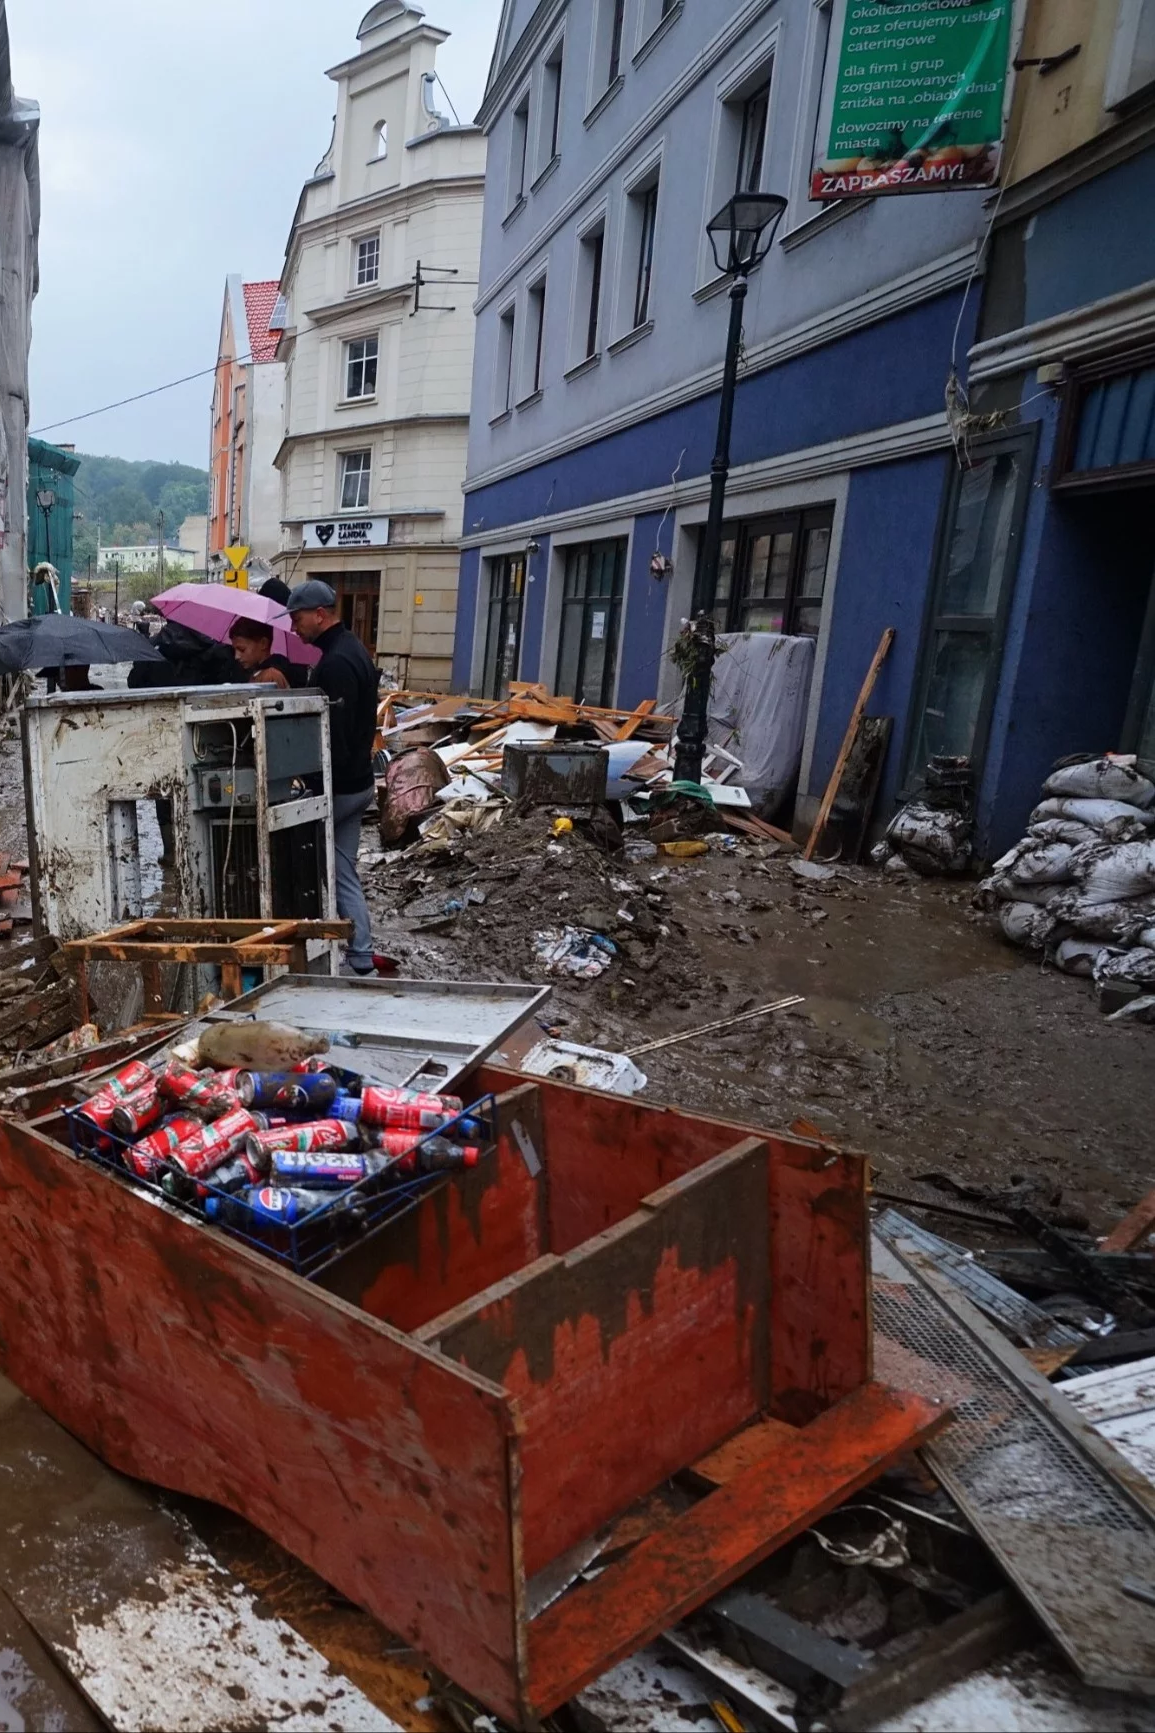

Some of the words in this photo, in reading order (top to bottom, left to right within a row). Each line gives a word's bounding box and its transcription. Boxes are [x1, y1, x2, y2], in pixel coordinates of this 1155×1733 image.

[849, 23, 880, 36] oraz
[884, 12, 958, 32] oferujemy
[962, 6, 1005, 24] usługi
[847, 33, 936, 52] cateringowe
[844, 64, 865, 77] dla
[869, 62, 898, 74] firm
[910, 58, 944, 73] grup
[842, 72, 966, 94] zorganizowanych
[840, 95, 884, 110] zniżka
[888, 95, 905, 105] na
[837, 118, 909, 134] dowozimy
[912, 118, 929, 128] na
[933, 108, 983, 124] terenie
[835, 138, 880, 150] miasta
[820, 163, 964, 193] ZAPRASZAMY!
[283, 1152, 362, 1168] TIGER
